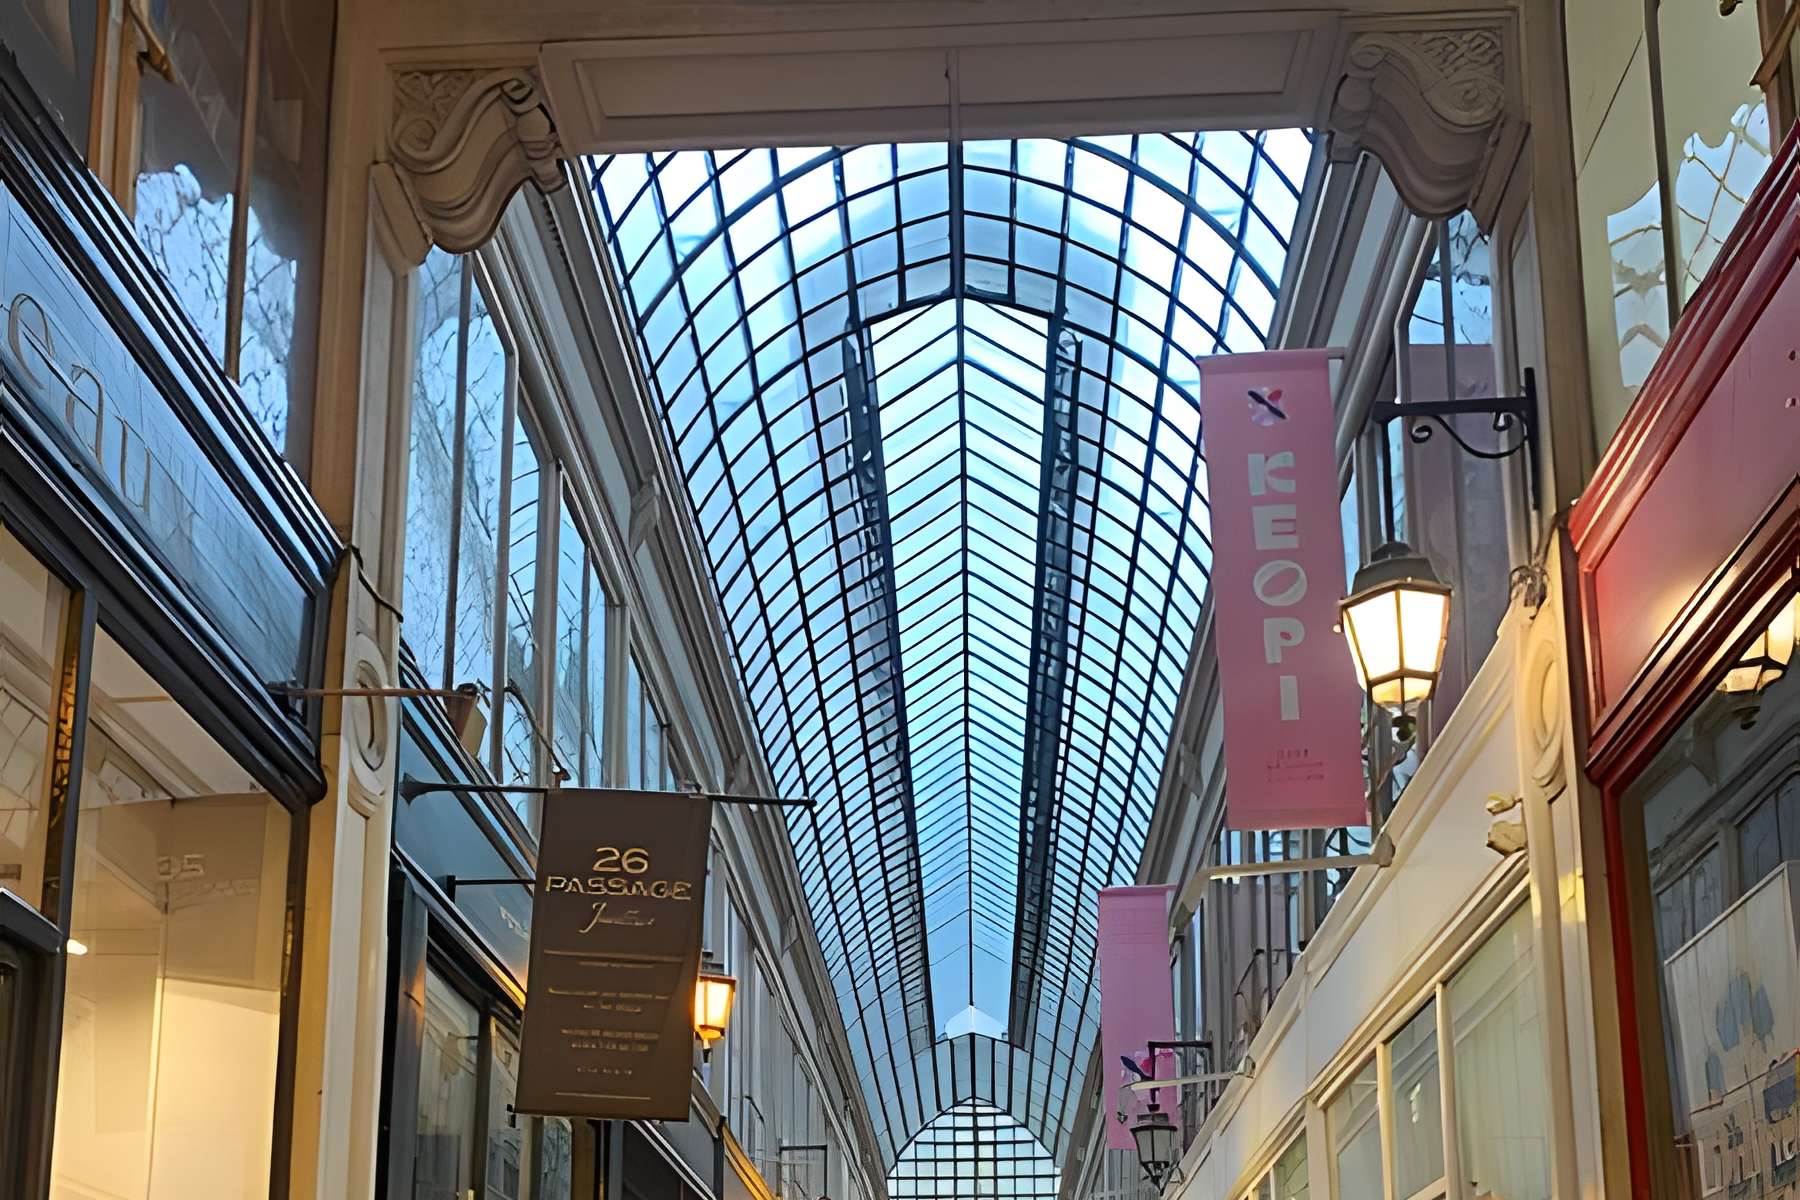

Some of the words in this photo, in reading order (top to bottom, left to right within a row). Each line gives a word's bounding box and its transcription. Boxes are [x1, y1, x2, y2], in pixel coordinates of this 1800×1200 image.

[1247, 451, 1308, 721] KEOPI
[592, 847, 649, 874] 26
[545, 876, 692, 900] PASSAGE
